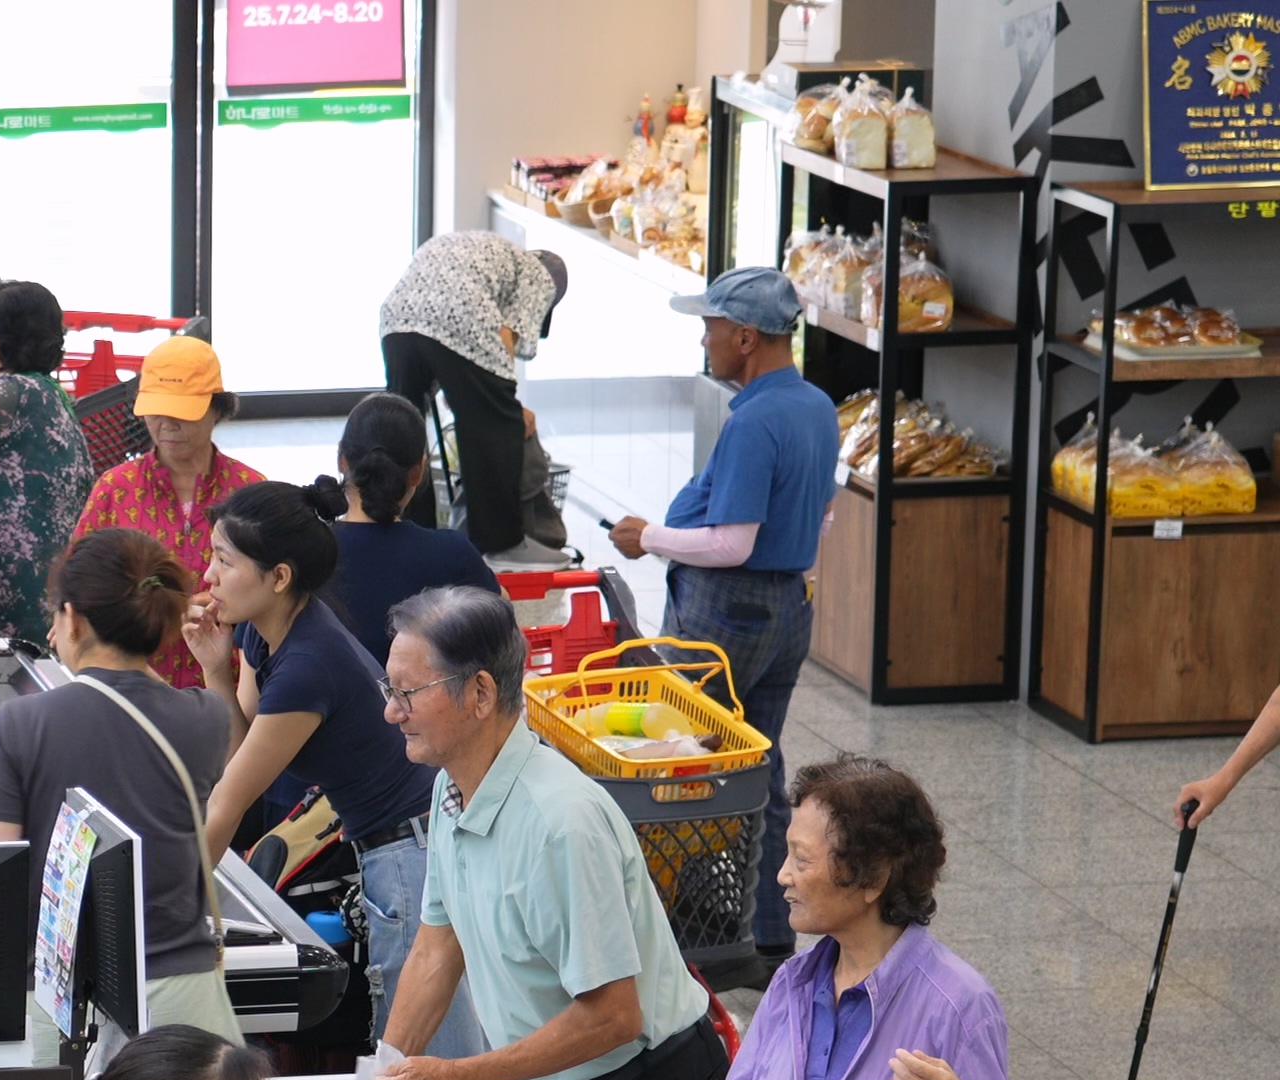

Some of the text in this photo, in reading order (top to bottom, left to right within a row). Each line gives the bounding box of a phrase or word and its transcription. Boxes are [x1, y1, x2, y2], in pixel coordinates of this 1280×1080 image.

[243, 1, 384, 27] 25.7.24~8.20
[1172, 20, 1207, 49] ABMC
[1206, 12, 1255, 32] BAKERY
[1164, 55, 1193, 91] 名
[225, 104, 301, 121] 하나로마트
